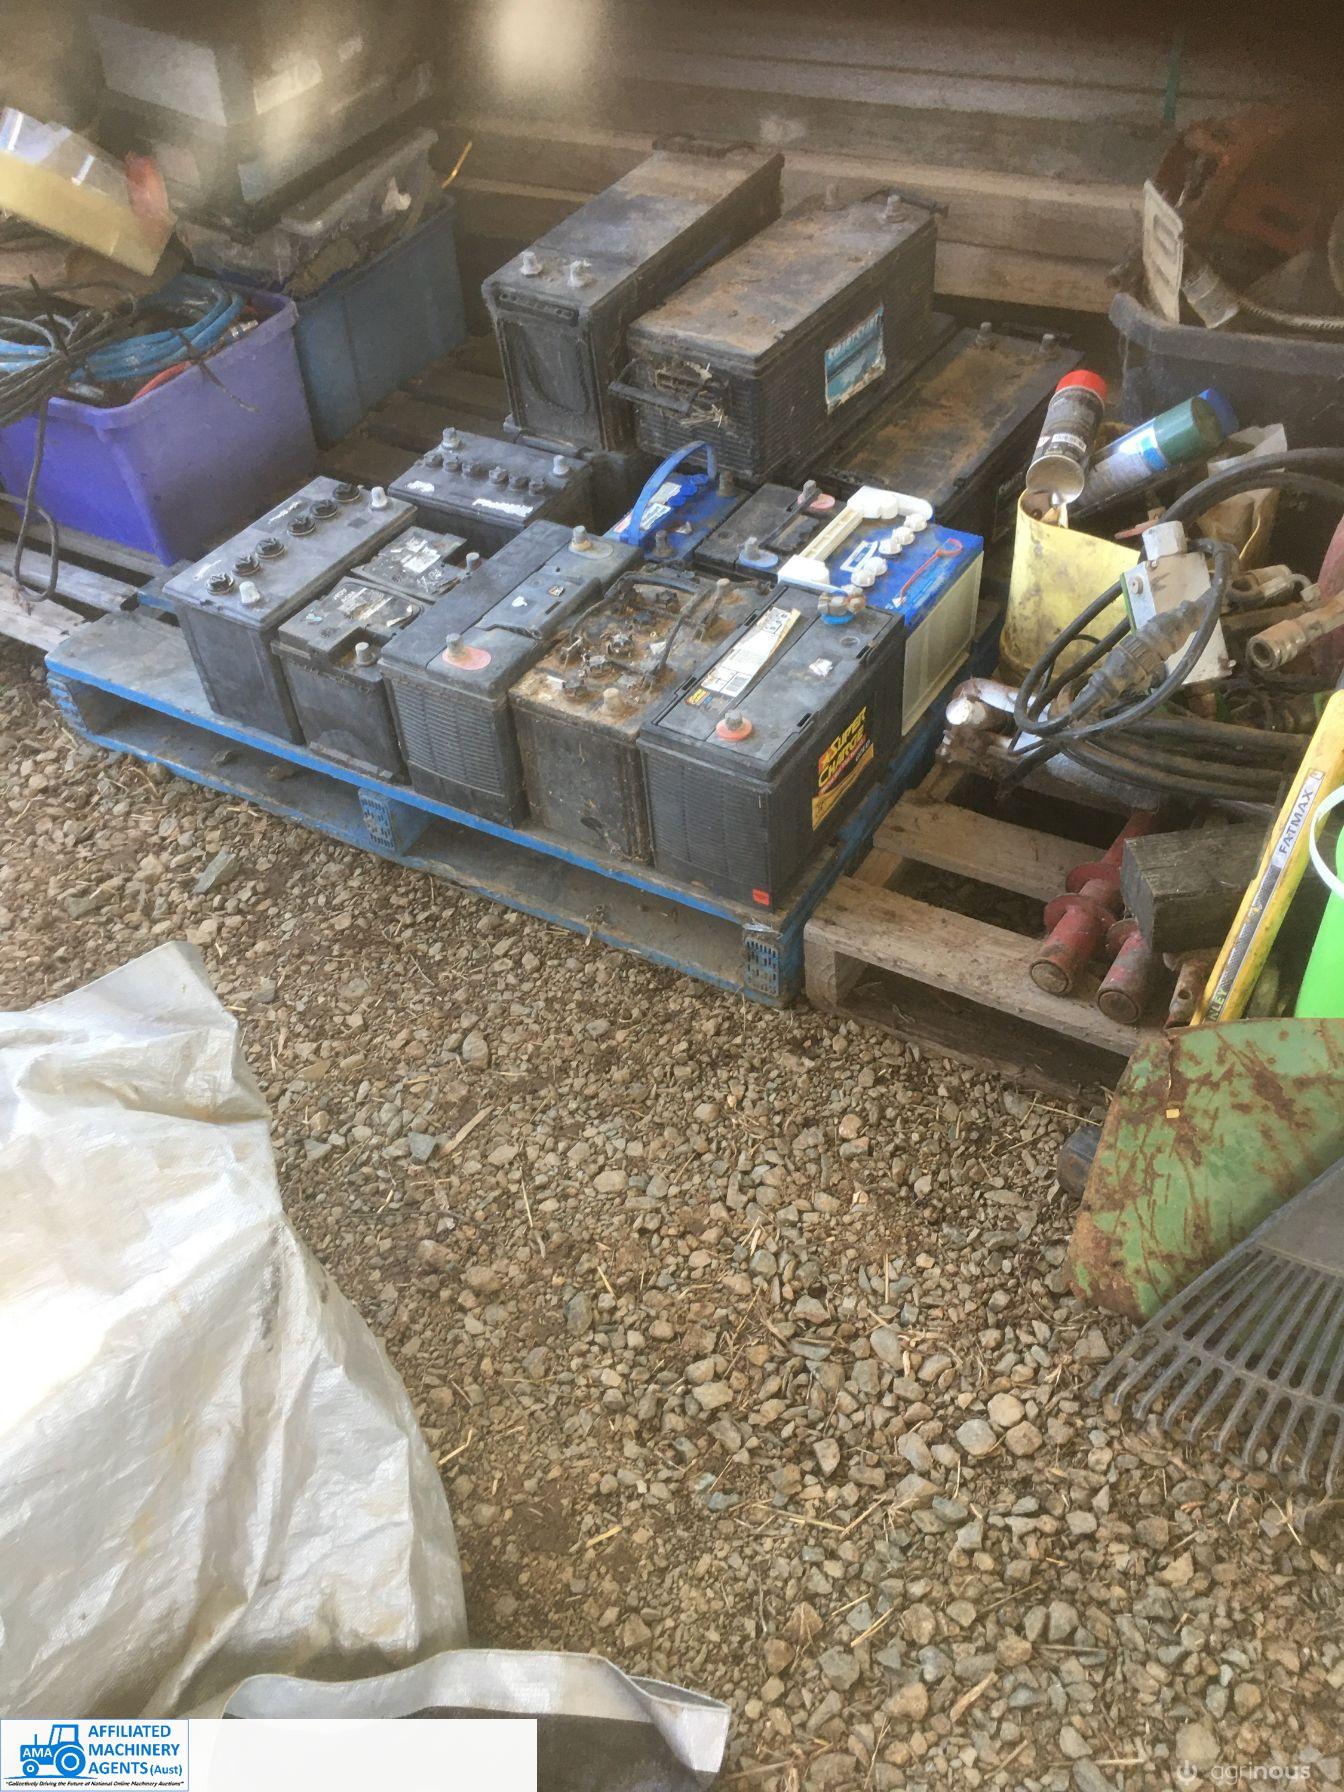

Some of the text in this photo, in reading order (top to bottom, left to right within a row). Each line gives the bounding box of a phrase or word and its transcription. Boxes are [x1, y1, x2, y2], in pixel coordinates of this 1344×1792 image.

[818, 724, 865, 788] CHARGE
[829, 705, 867, 763] SUPER
[1278, 788, 1314, 855] FATMAX
